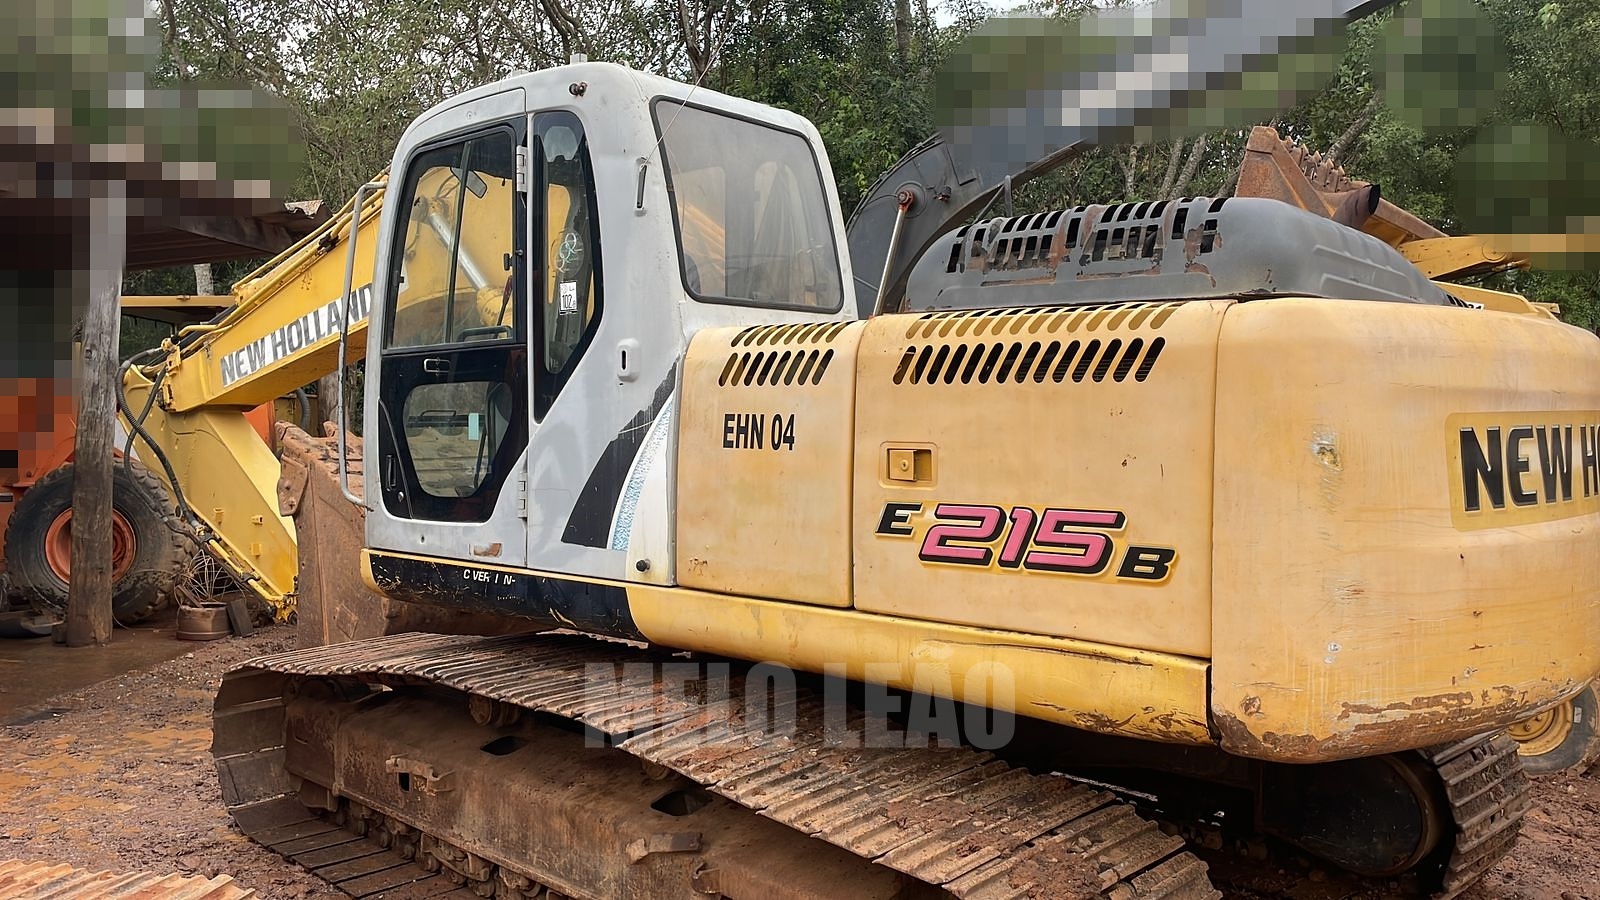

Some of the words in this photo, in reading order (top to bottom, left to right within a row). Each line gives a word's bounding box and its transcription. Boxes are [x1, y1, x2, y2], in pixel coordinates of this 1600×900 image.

[220, 337, 266, 387] NEW
[722, 413, 765, 450] EHN
[770, 413, 795, 451] 04
[1459, 424, 1573, 512] NEW
[1580, 424, 1600, 498] H
